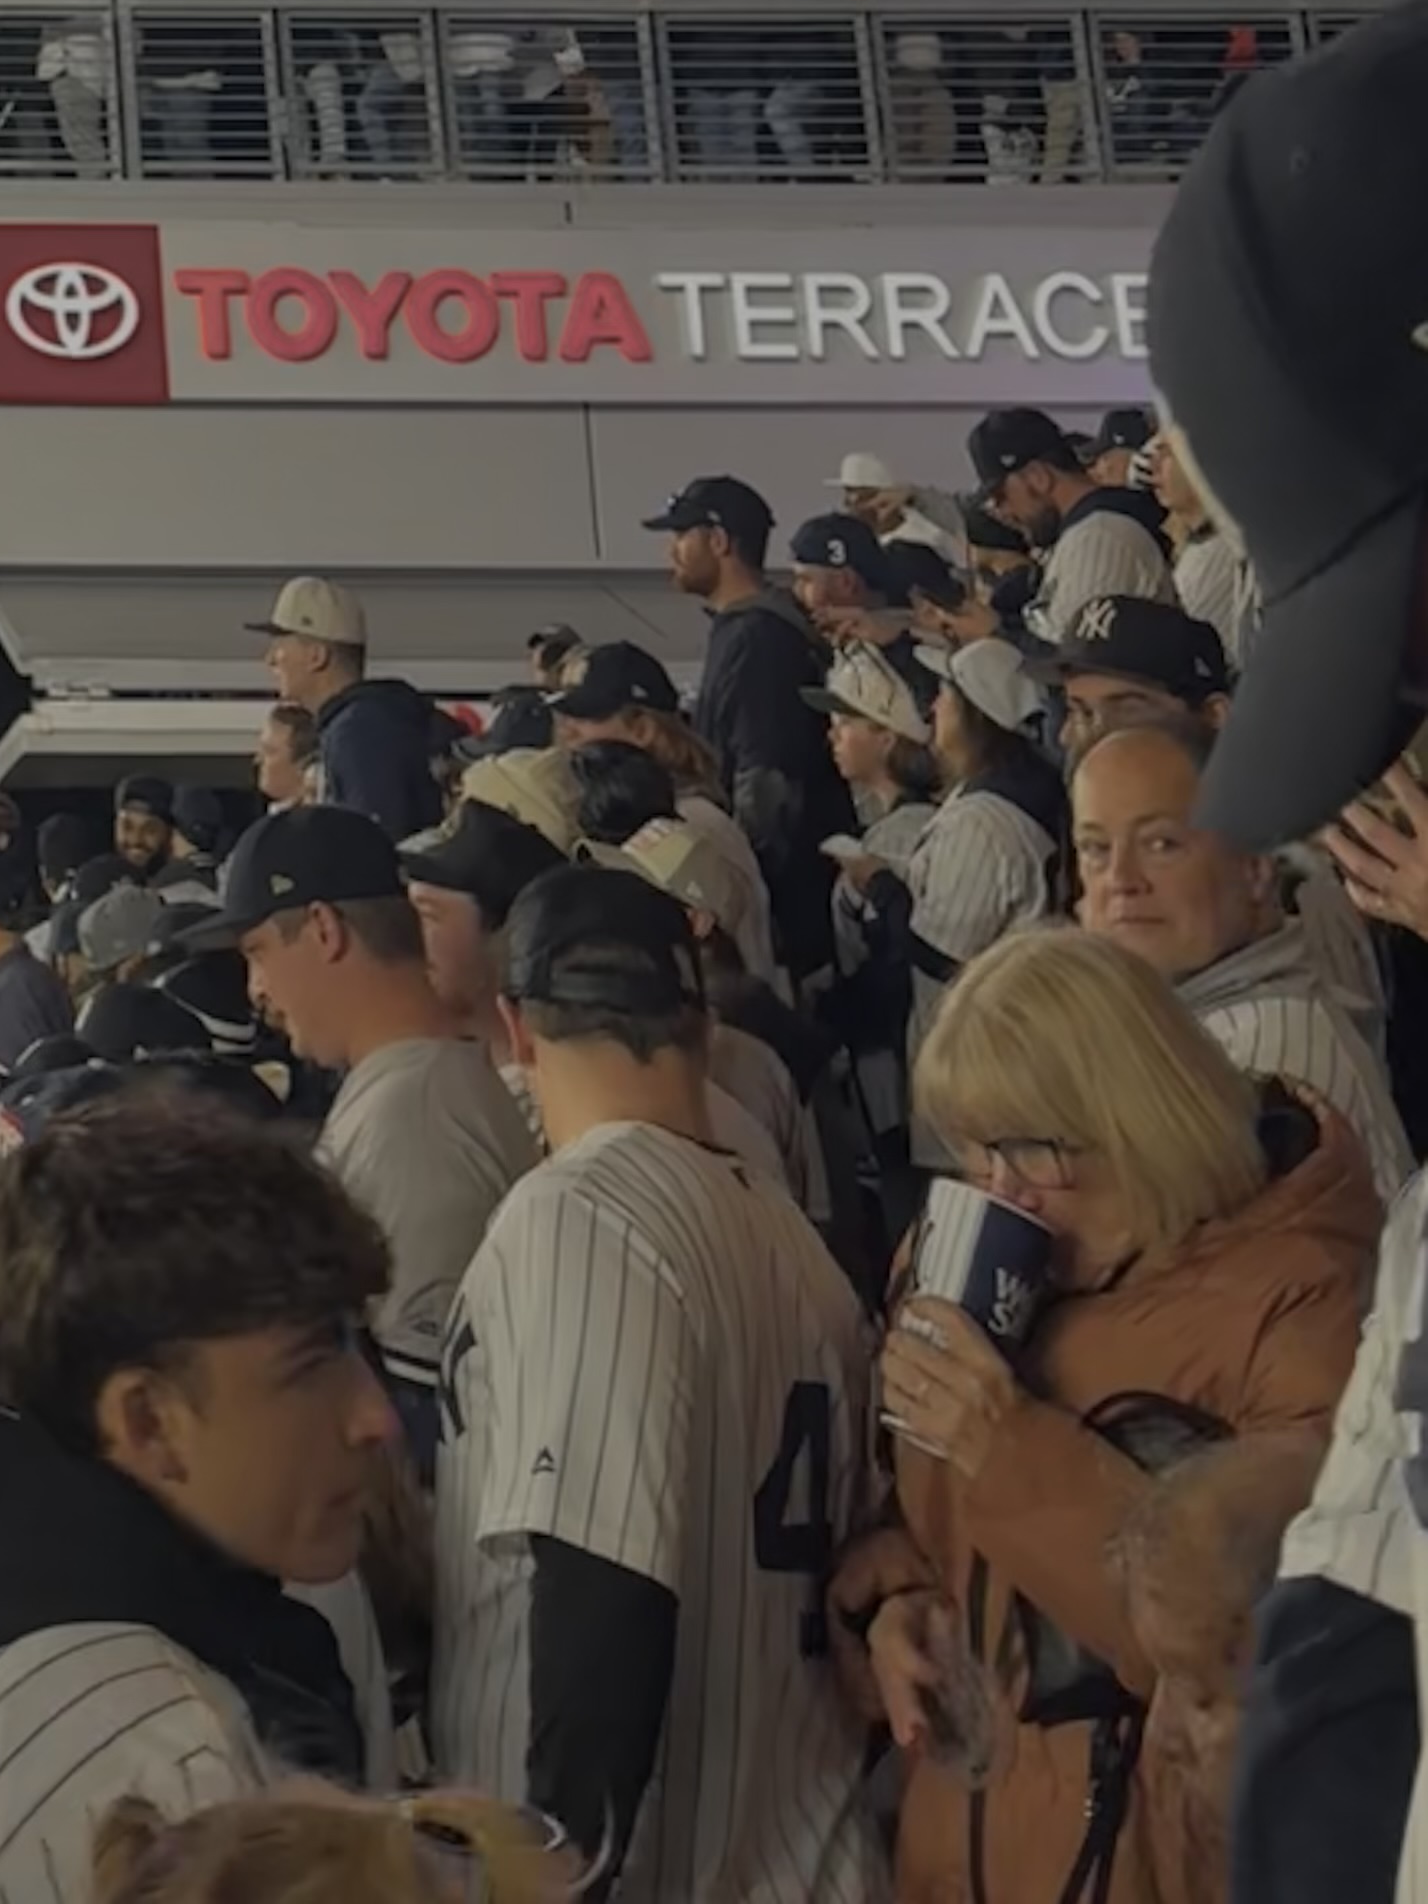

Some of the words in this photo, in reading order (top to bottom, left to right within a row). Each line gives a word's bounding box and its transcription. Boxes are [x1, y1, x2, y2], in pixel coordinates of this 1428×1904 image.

[175, 266, 655, 364] TOYOTA
[657, 270, 1151, 362] TERRACE
[826, 538, 847, 566] 3
